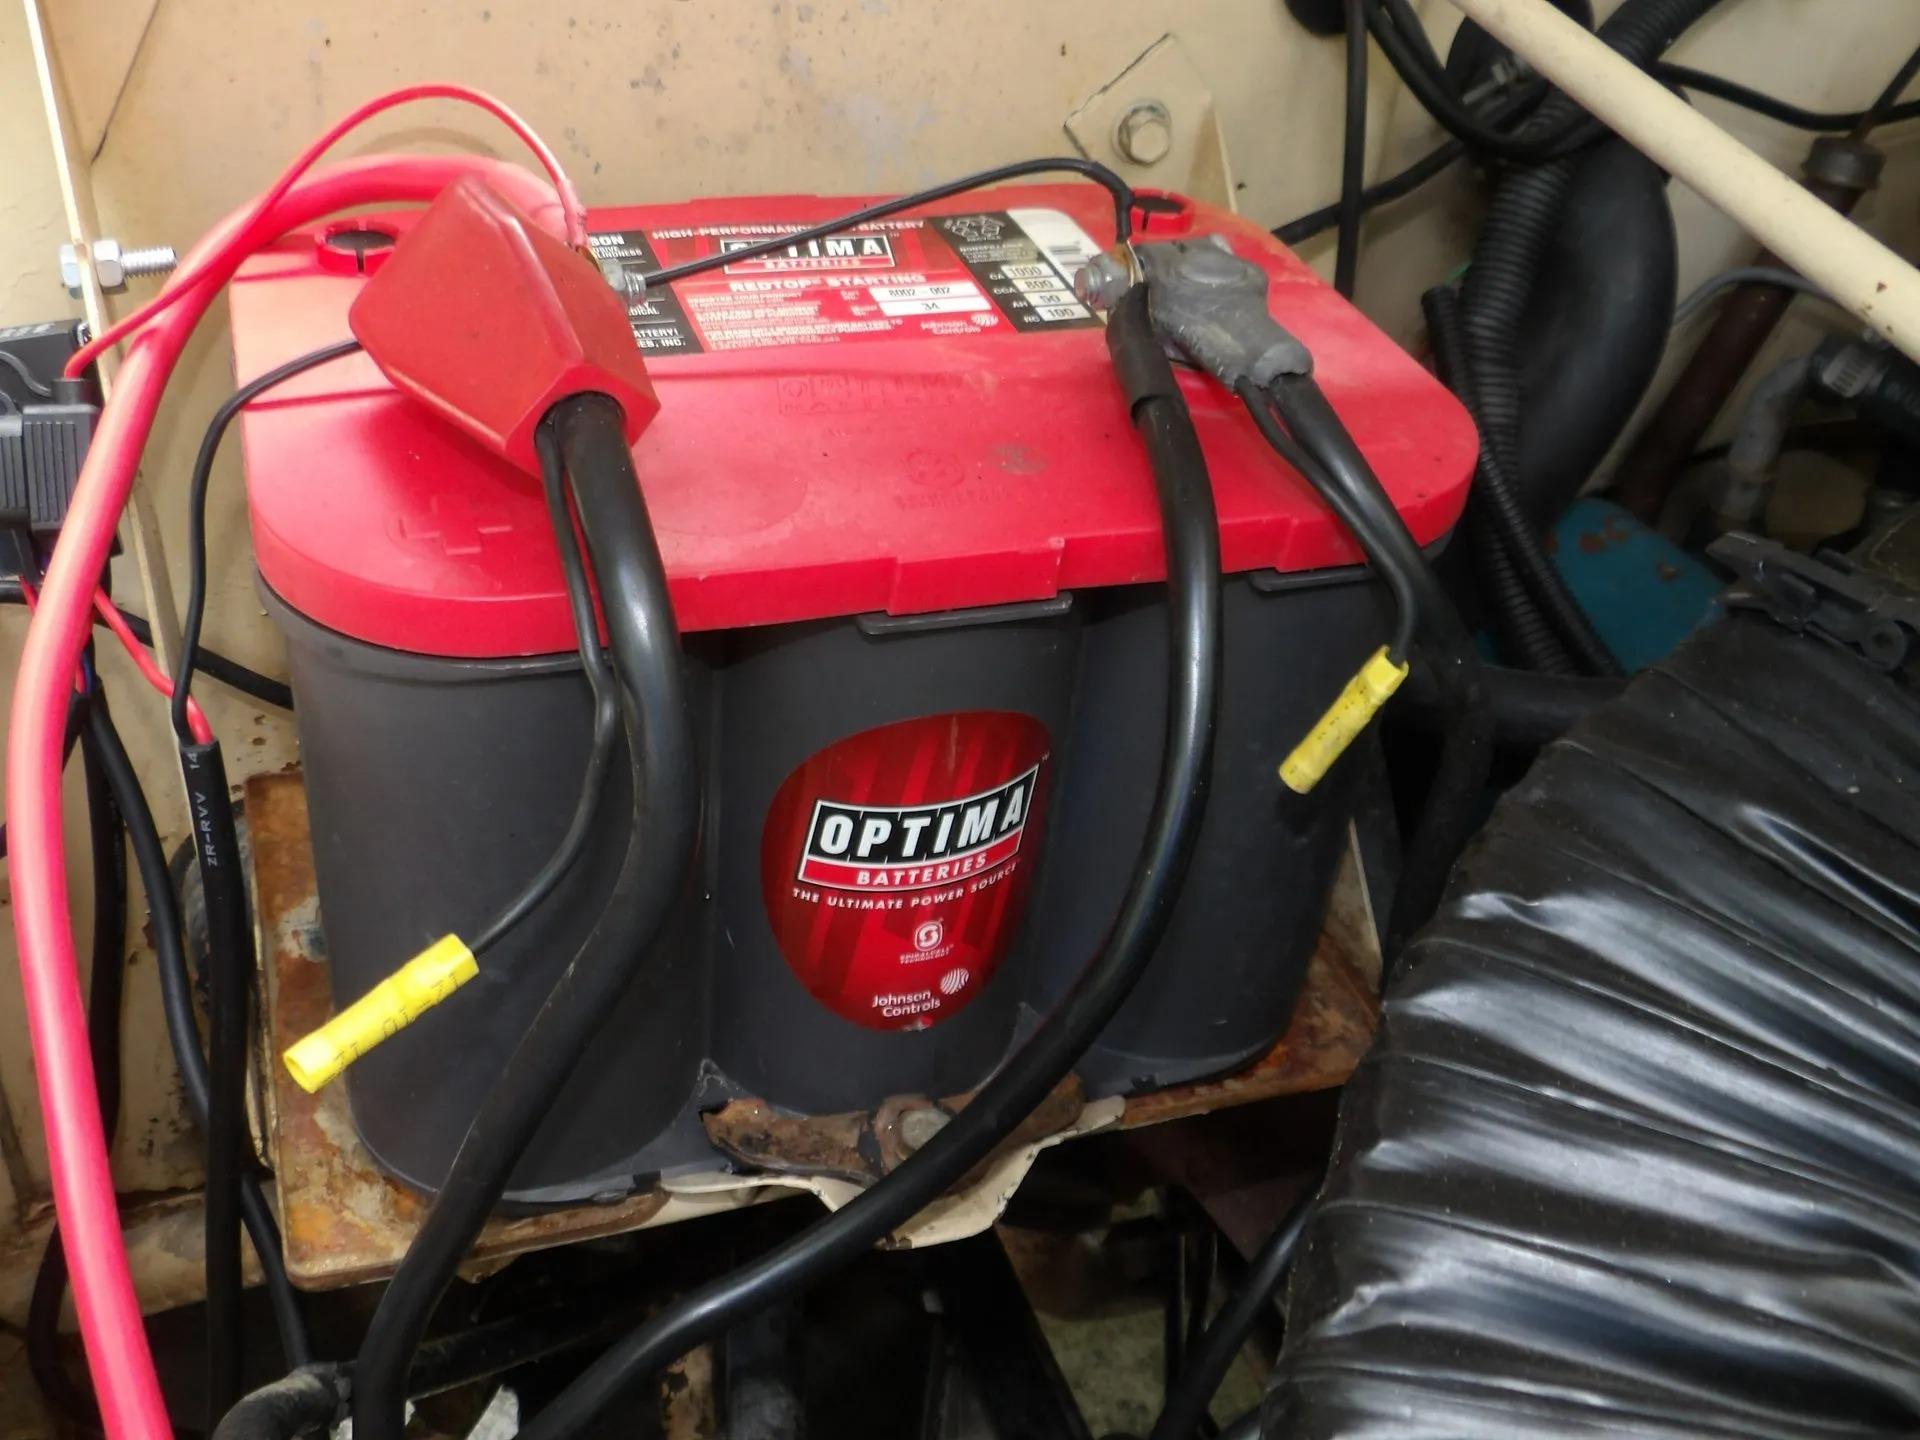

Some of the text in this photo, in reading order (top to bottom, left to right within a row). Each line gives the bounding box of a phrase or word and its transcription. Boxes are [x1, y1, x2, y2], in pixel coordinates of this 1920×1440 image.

[858, 220, 924, 232] BATTERY
[765, 258, 861, 270] BATTERIES
[1010, 266, 1042, 277] 1000
[825, 273, 926, 288] STARTING
[922, 302, 941, 312] 34
[819, 784, 1024, 858] OPTIMA
[856, 852, 987, 886] BATTERIES
[793, 862, 1017, 911] THE ULTIMATE POWER SOURCE
[872, 990, 931, 1008] Johnson
[882, 999, 940, 1018] Controls
